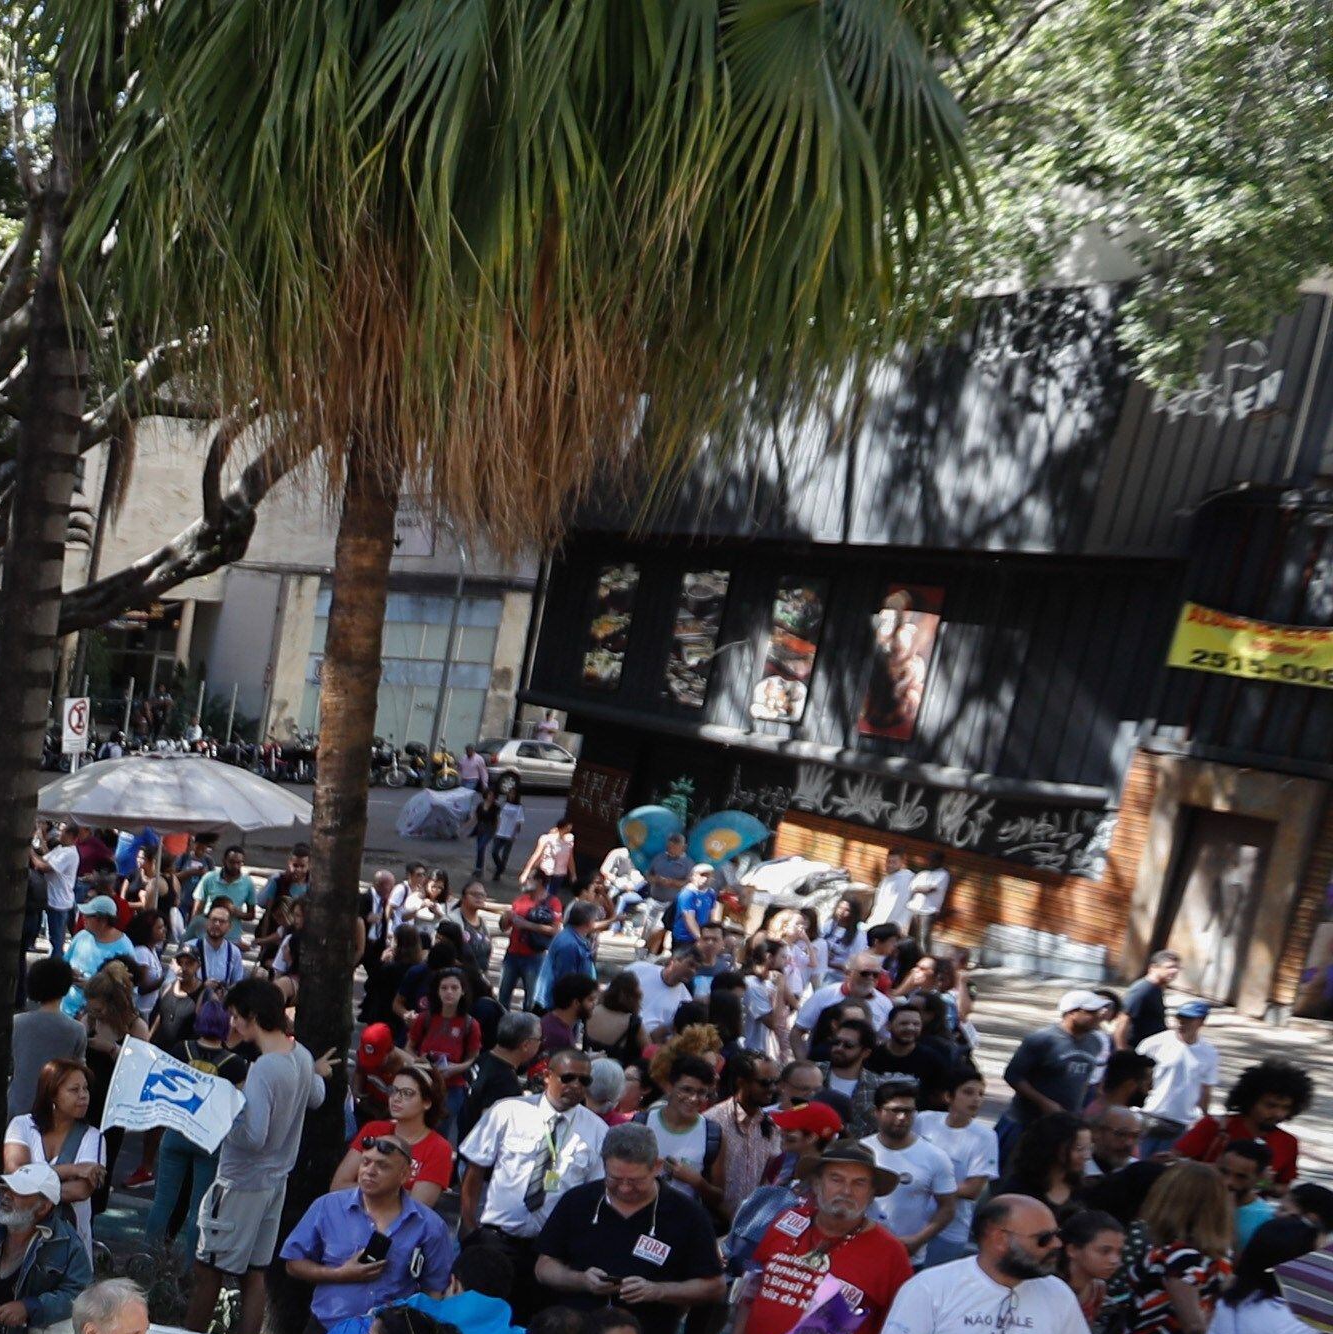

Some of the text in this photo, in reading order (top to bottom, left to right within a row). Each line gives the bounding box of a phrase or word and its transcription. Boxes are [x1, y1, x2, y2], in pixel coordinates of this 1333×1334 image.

[783, 1211, 811, 1231] FORA
[637, 1236, 668, 1258] FORA
[771, 1275, 805, 1295] Brasil
[780, 1293, 798, 1307] de
[964, 1310, 993, 1326] NÃO
